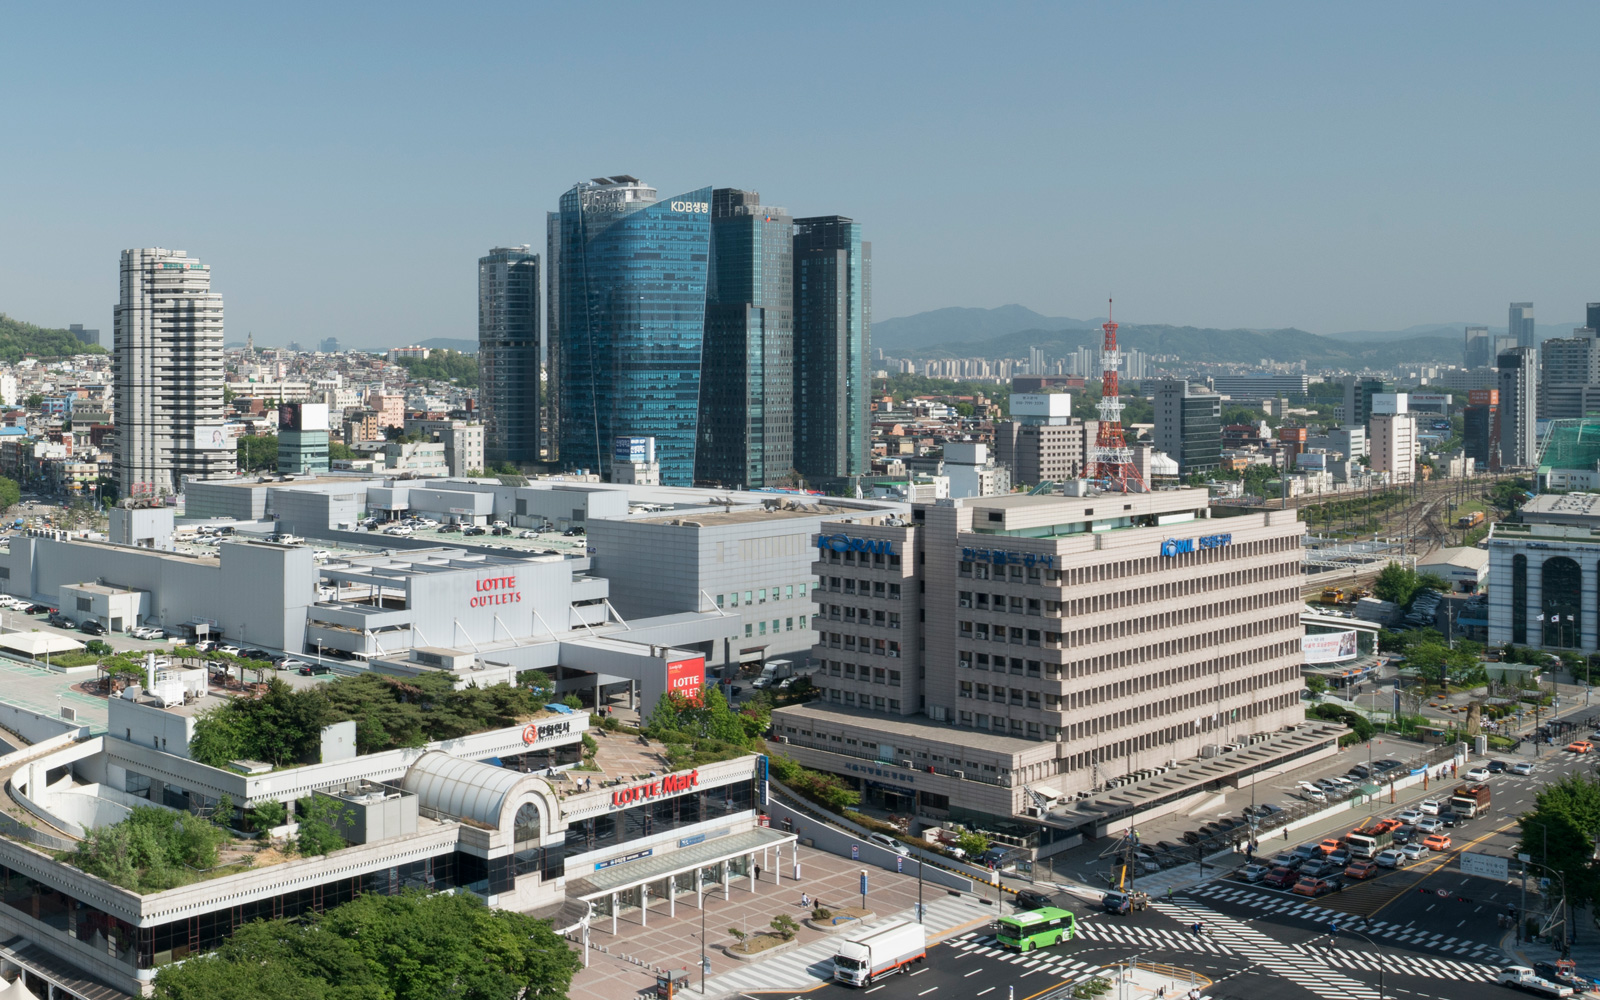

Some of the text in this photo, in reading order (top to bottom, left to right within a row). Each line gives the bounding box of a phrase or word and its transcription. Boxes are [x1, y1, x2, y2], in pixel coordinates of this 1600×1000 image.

[670, 201, 709, 213] KDB생명
[817, 534, 896, 556] KORAIL
[1161, 537, 1196, 558] KORAIL
[962, 547, 1054, 568] 한국철도공사
[476, 576, 516, 592] LOTTE
[470, 591, 521, 608] OUTLETS
[673, 675, 699, 688] LOTTE
[538, 721, 571, 741] 한화역사
[614, 769, 699, 806] LOTTE Mart
